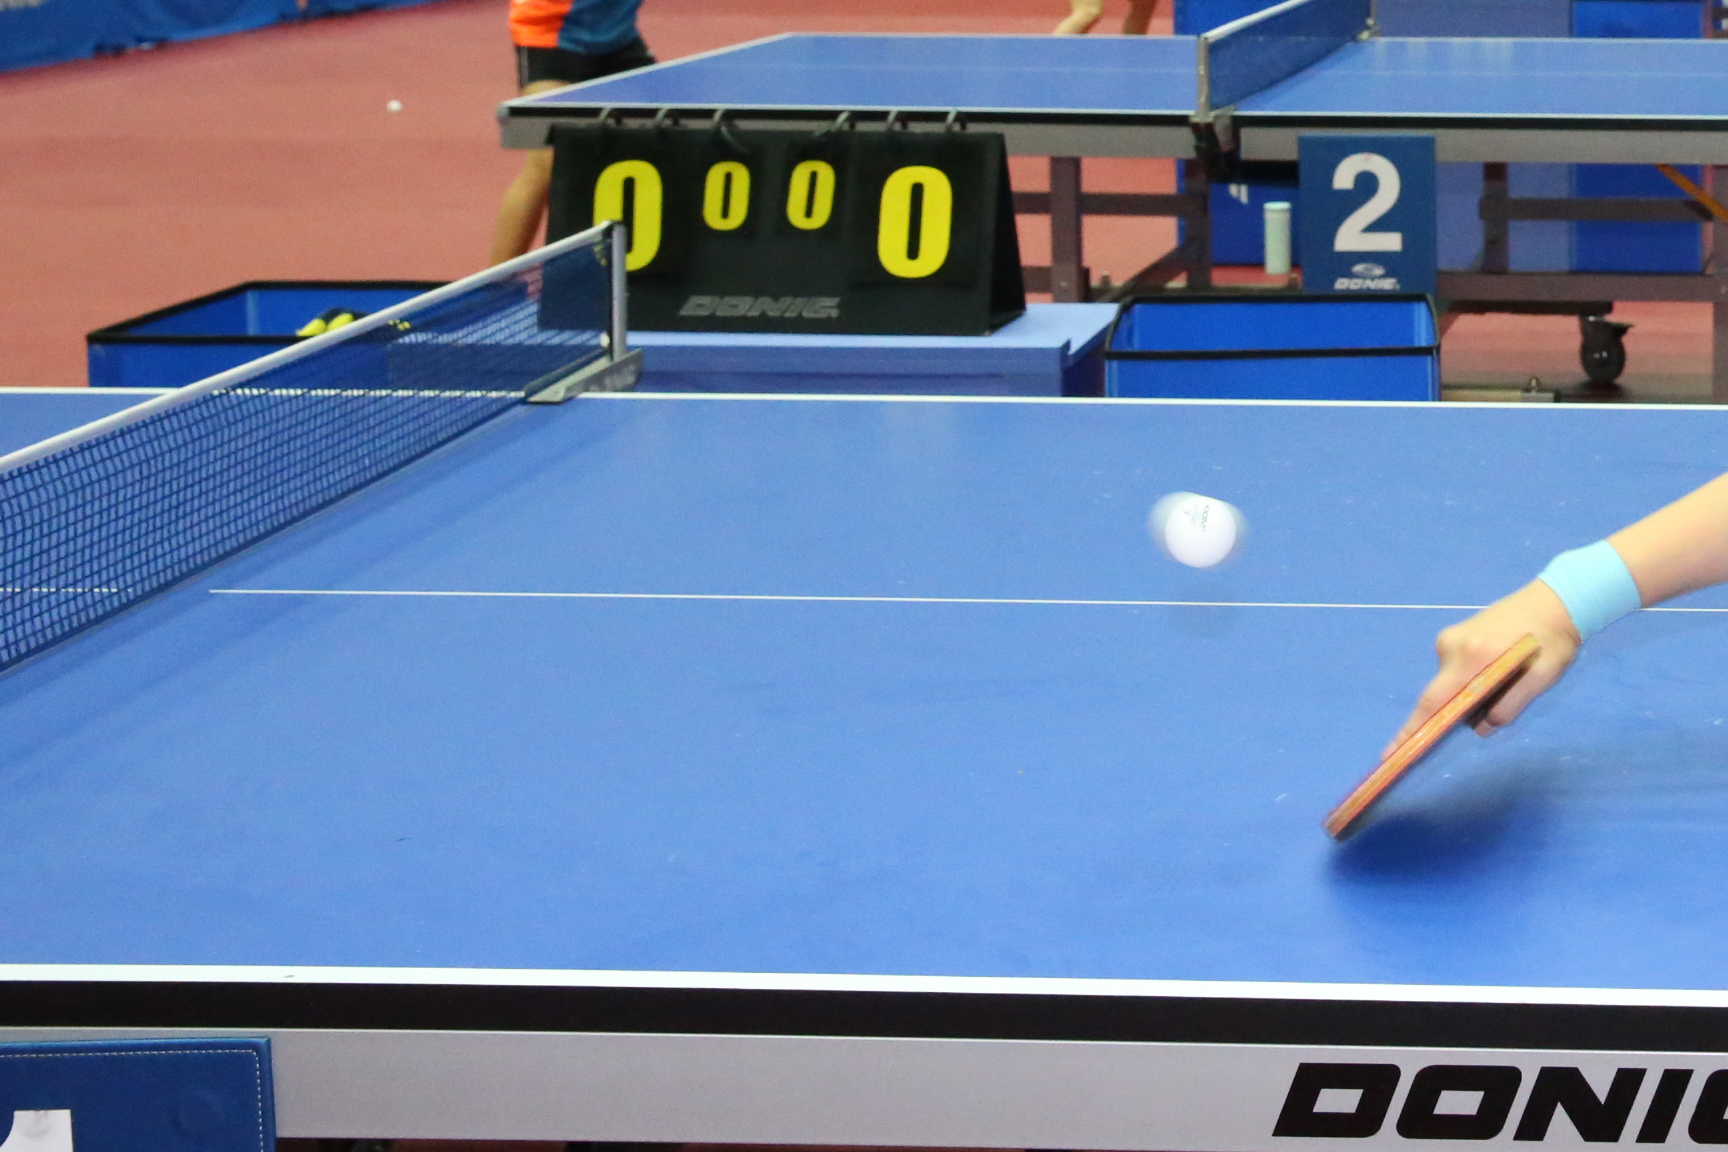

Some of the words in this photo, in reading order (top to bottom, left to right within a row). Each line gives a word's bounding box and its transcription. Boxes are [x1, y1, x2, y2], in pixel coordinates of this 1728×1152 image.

[593, 159, 663, 272] 0
[703, 161, 751, 231] 0
[786, 160, 836, 230] 0
[877, 165, 953, 279] 0
[1332, 151, 1403, 252] 2
[678, 295, 840, 318] DONIC
[1334, 277, 1399, 290] DONIC
